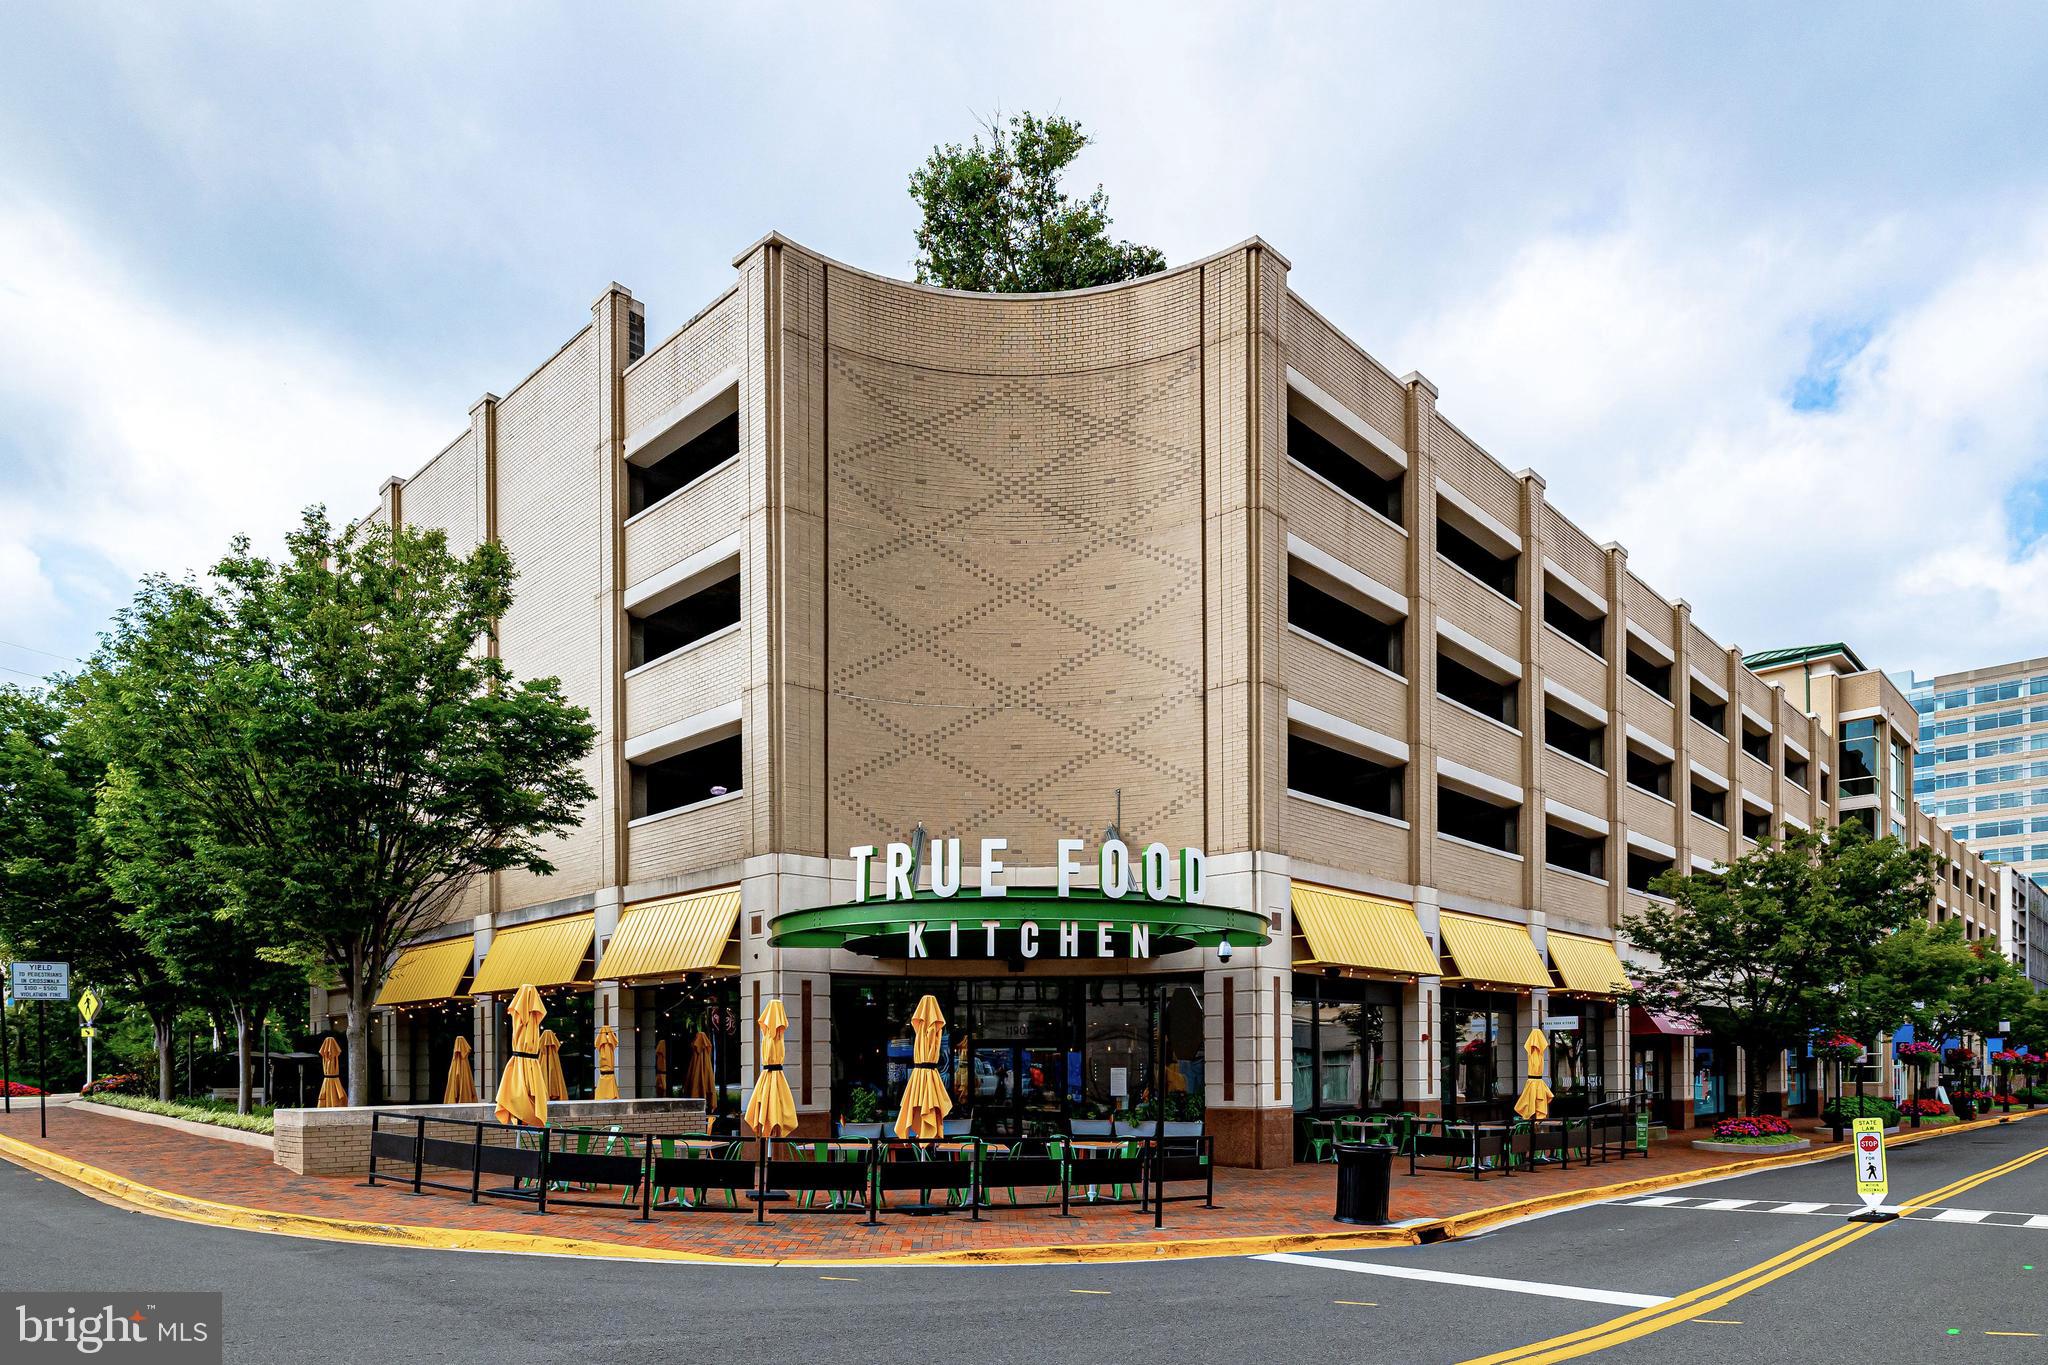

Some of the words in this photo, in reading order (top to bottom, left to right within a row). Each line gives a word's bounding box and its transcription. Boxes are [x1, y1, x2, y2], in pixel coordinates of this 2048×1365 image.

[850, 838, 1008, 903] TRUE
[1057, 839, 1206, 903] FOOD
[908, 920, 1149, 958] KITCHEN
